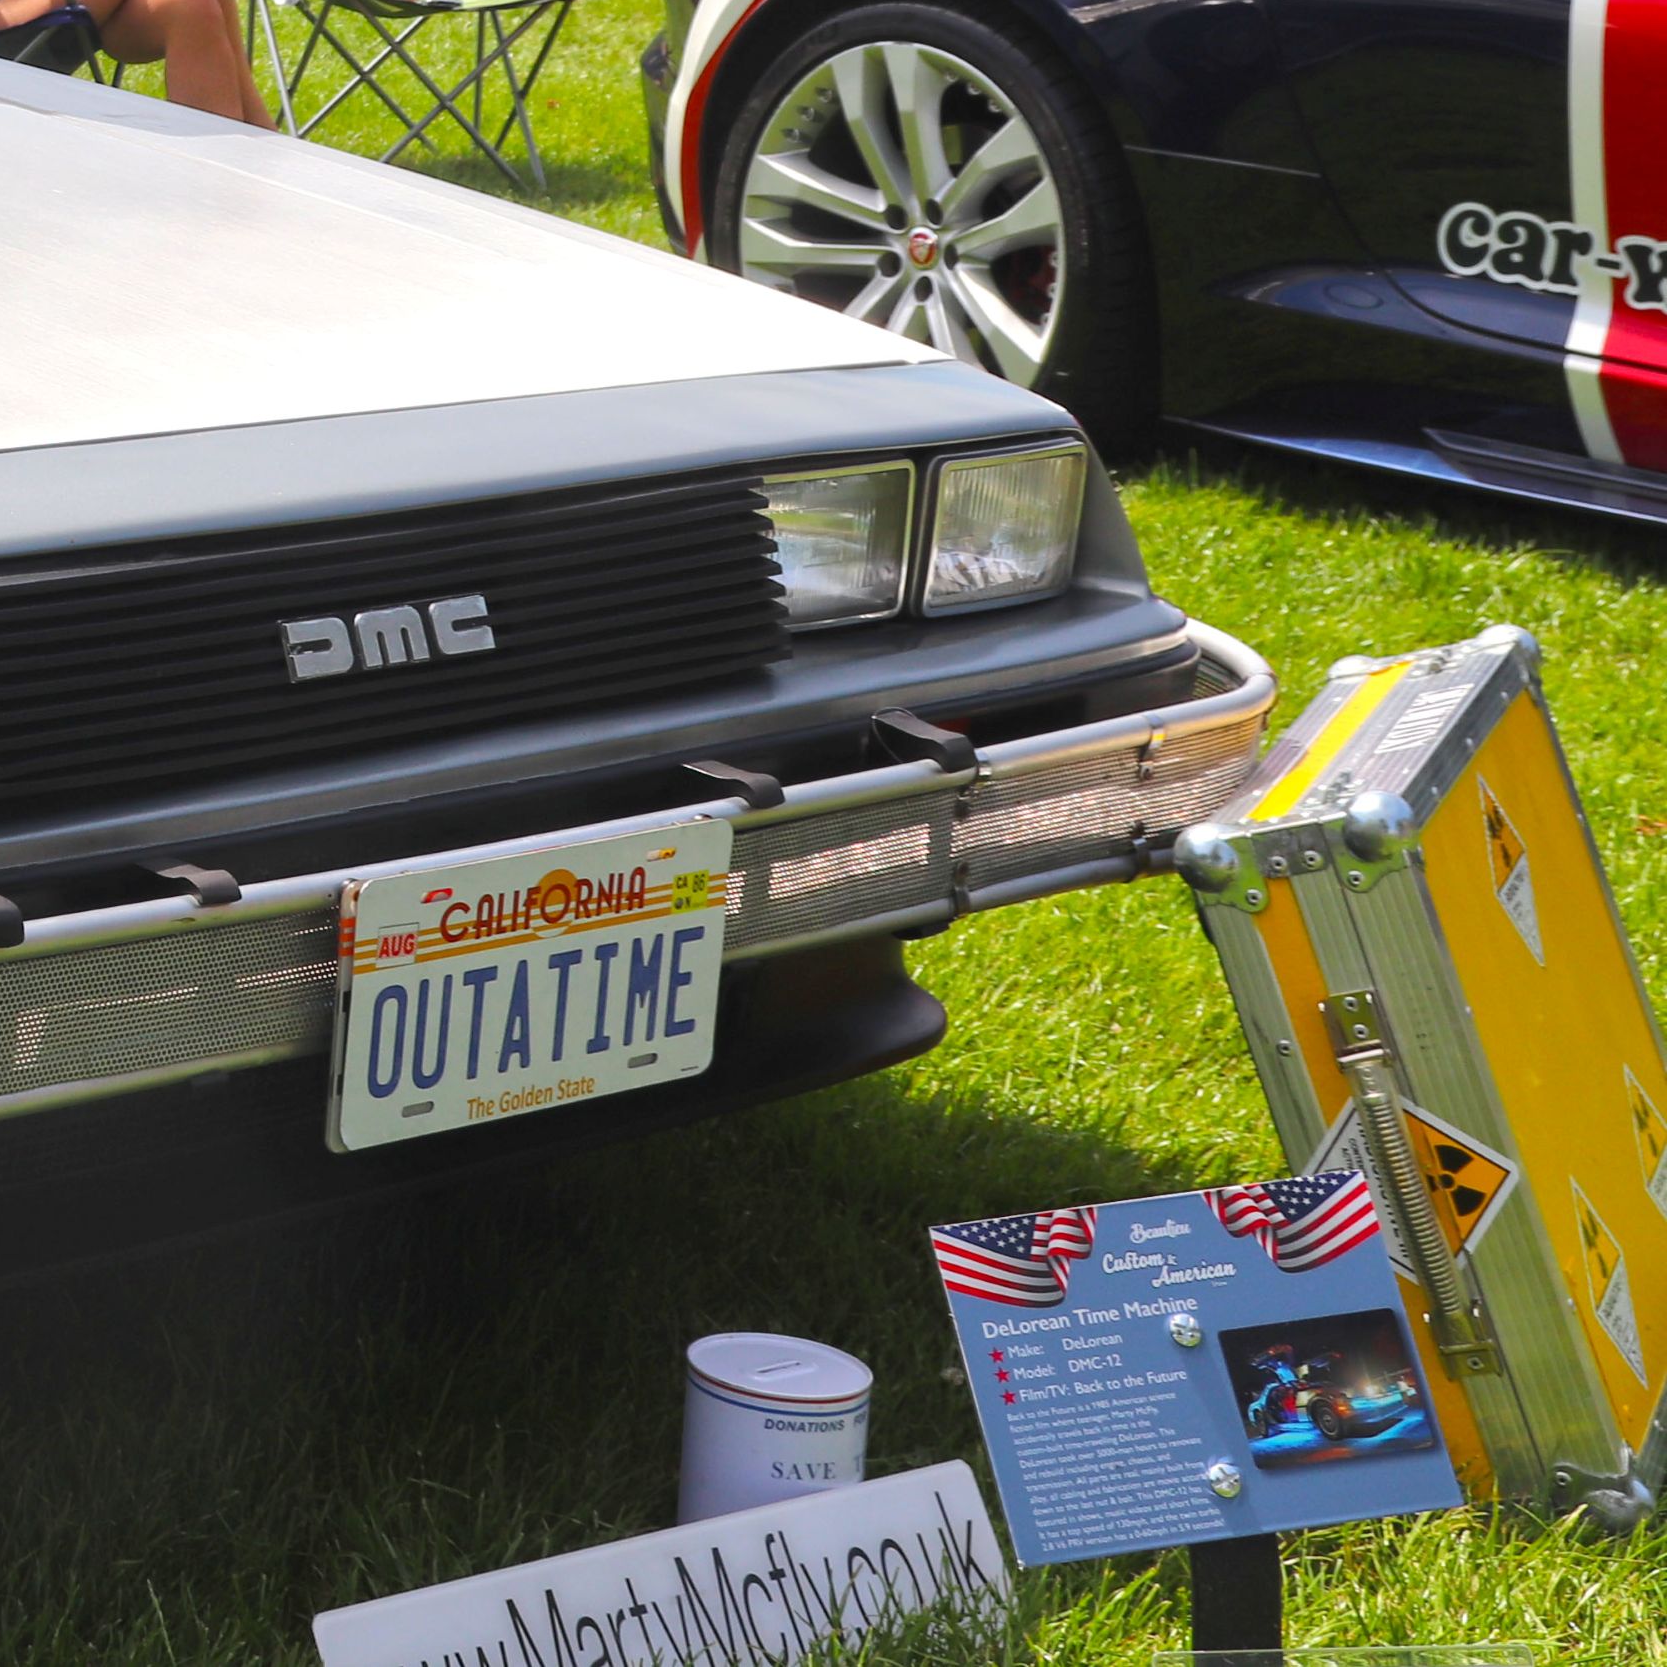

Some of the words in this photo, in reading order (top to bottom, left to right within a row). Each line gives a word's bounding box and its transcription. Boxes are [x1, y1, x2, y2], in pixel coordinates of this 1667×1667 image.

[280, 593, 495, 683] DMC
[440, 866, 646, 943] CALIFORNIA
[378, 934, 415, 959] AUG
[367, 925, 706, 1099] OUTATIME
[467, 1097, 494, 1120] The
[499, 1085, 554, 1114] Golden
[556, 1075, 595, 1101] State
[1130, 1219, 1191, 1244] Beaulieu
[1103, 1251, 1165, 1274] Custom
[1152, 1261, 1237, 1288] American
[982, 1313, 1071, 1340] DeLorean
[1072, 1306, 1120, 1327] Time
[1123, 1297, 1199, 1319] Machine
[1007, 1344, 1044, 1359] Make:
[1062, 1333, 1124, 1352] DeLorean
[1013, 1364, 1056, 1382] Model:
[1068, 1353, 1124, 1374] DMC-12
[1019, 1383, 1072, 1403] Film/TV:
[1075, 1379, 1104, 1396] Back
[1108, 1377, 1120, 1390] to
[1124, 1374, 1144, 1389] the
[1146, 1368, 1188, 1387] Future
[764, 1418, 845, 1433] DONATIONS
[770, 1461, 836, 1480] SAVE
